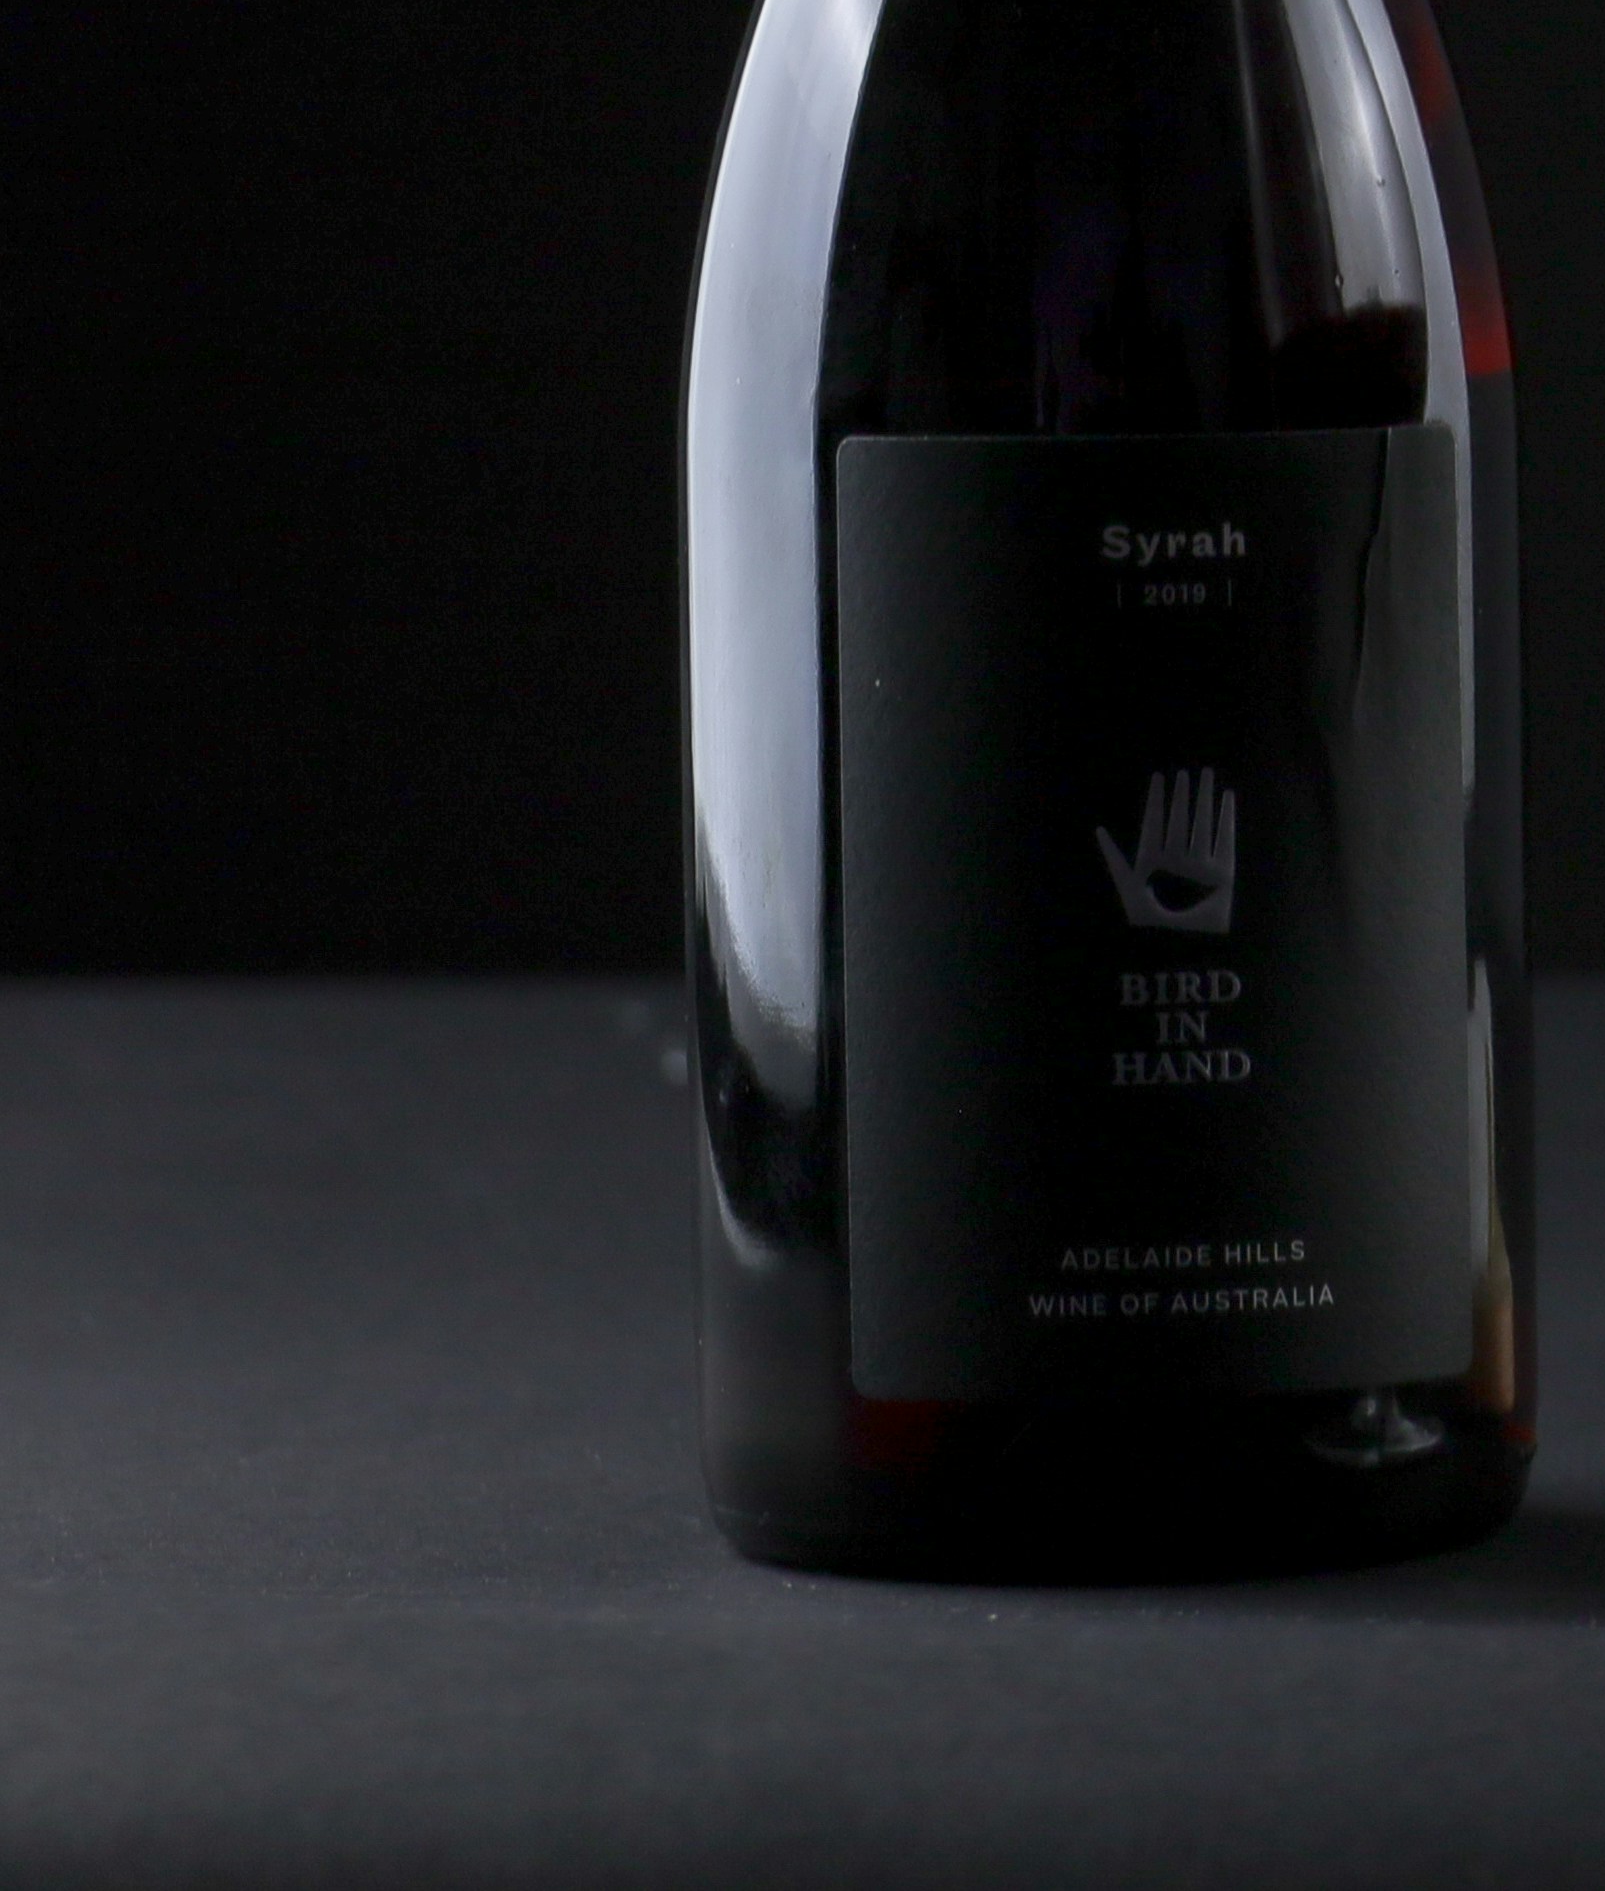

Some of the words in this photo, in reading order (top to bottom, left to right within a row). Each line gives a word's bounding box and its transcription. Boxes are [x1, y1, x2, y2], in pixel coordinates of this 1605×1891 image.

[1101, 520, 1247, 568] Syrah
[1142, 581, 1208, 607] 2019
[1120, 968, 1244, 1006] BIRD
[1155, 1010, 1209, 1045] IN
[1112, 1049, 1253, 1085] HAND
[1060, 1244, 1212, 1271] ADELAIDE
[1224, 1239, 1306, 1266] HILLS
[1028, 1293, 1107, 1318] WINE
[1118, 1291, 1160, 1317] OF
[1171, 1282, 1335, 1313] AUSTRALIA
